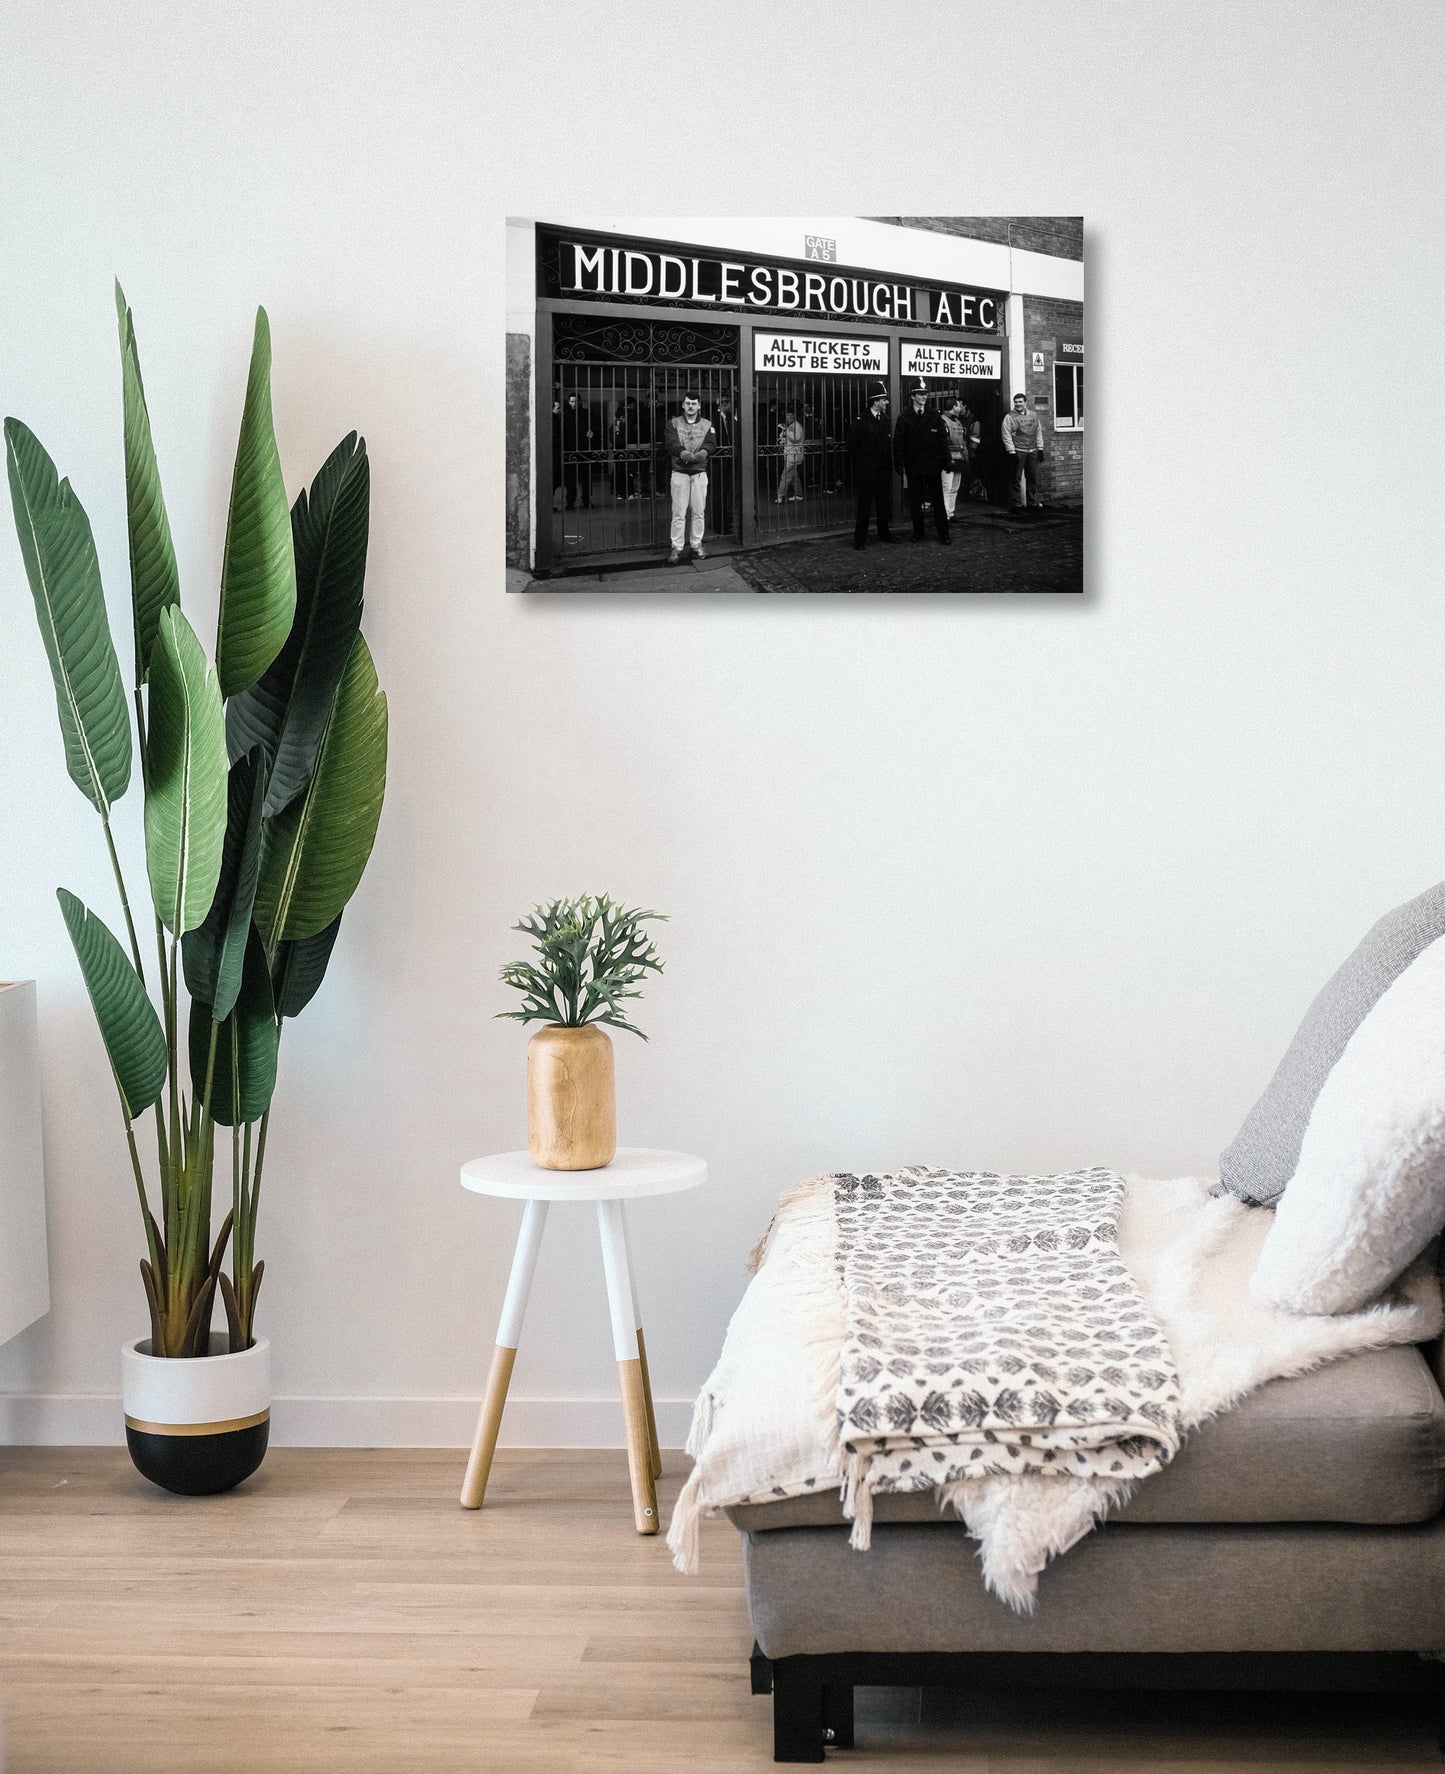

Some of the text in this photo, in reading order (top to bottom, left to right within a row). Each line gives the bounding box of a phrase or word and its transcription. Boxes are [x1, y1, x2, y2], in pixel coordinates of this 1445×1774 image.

[806, 236, 835, 251] GATE
[811, 248, 830, 261] A 5
[573, 244, 995, 329] MIDDLESBROUGH AFC
[771, 339, 870, 356] ALL TICKETS
[763, 354, 881, 371] MUST BE SHOWN
[915, 348, 985, 363] ALL TICKETS
[908, 361, 993, 376] MUST BE SHOWN
